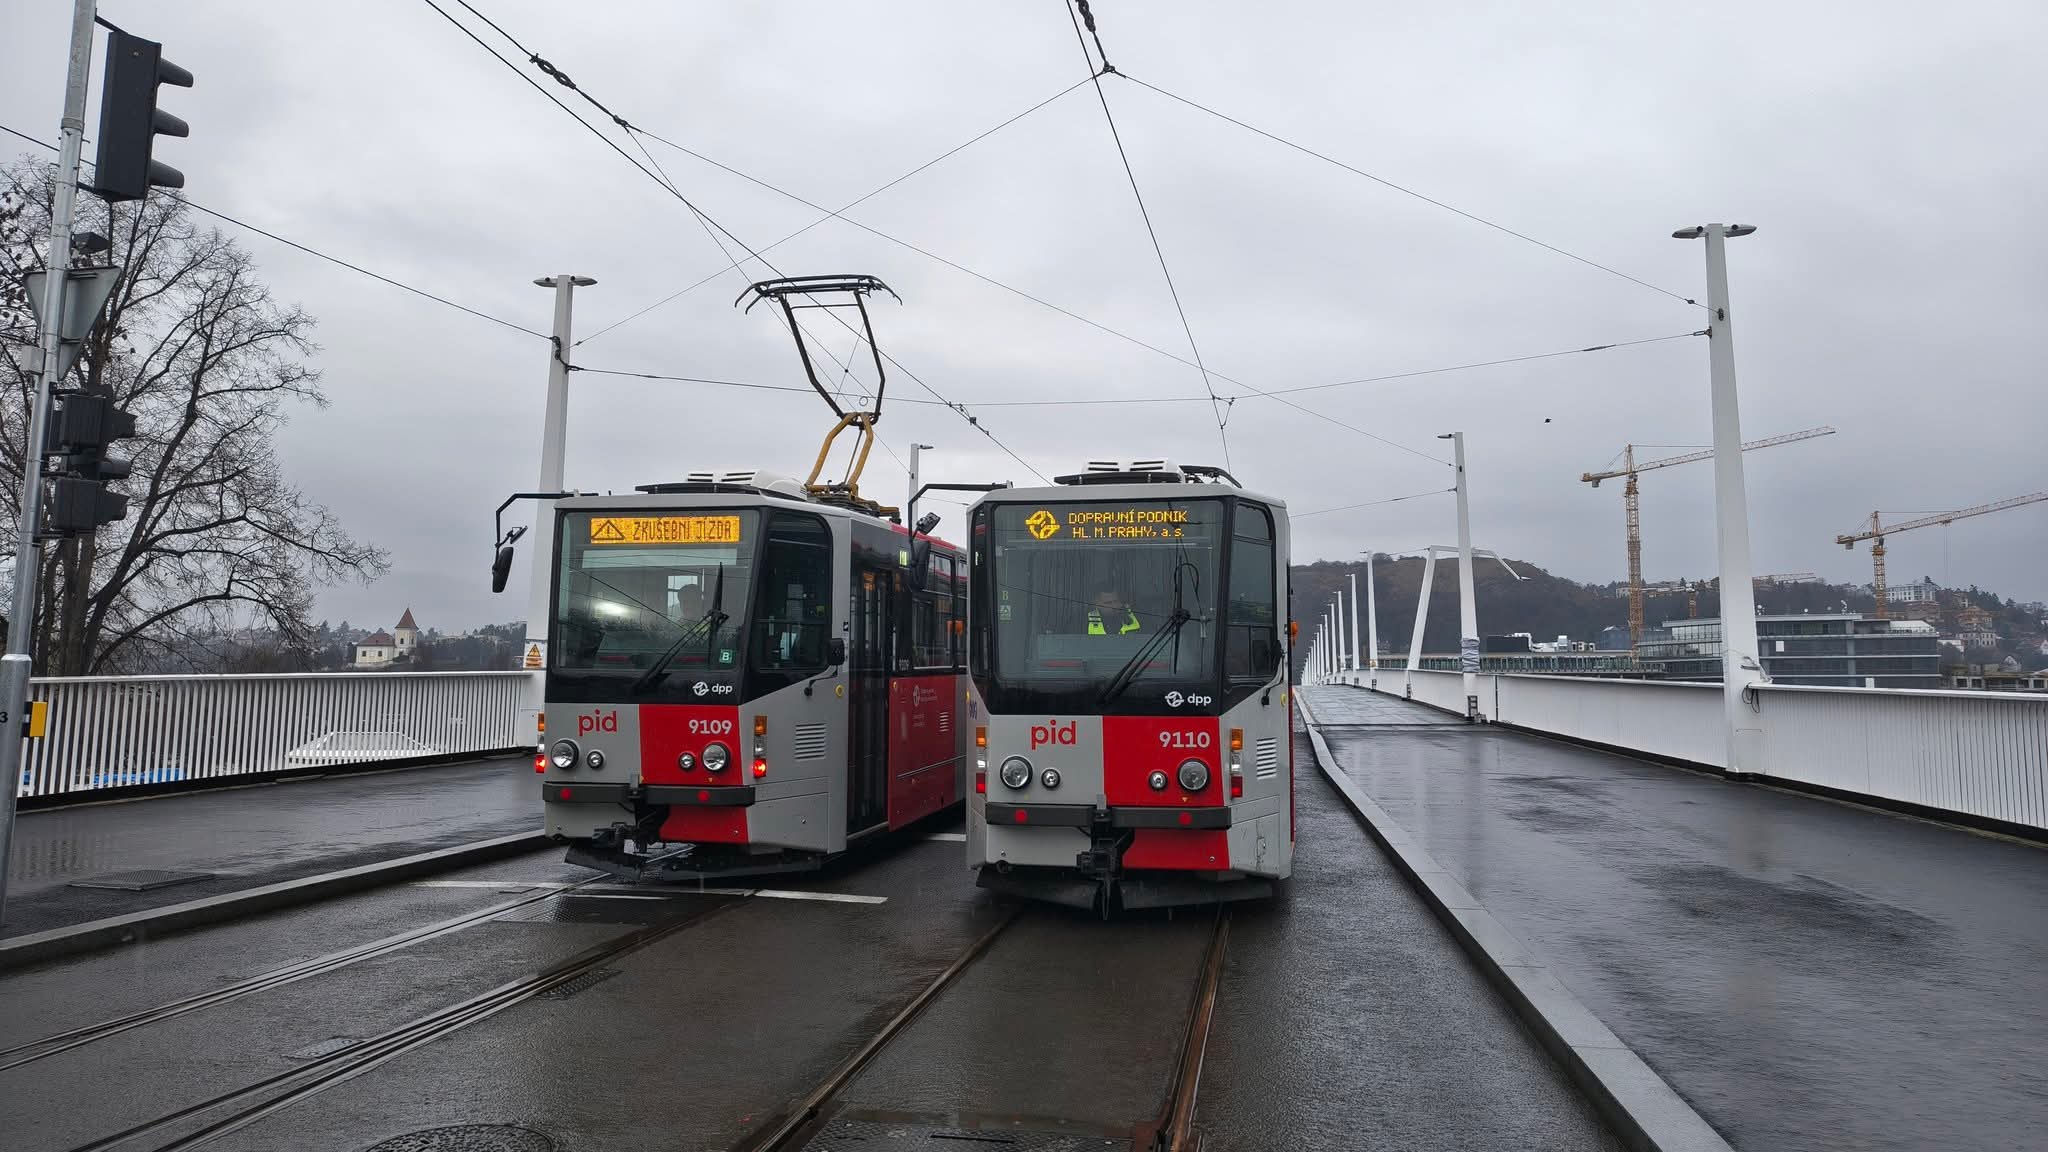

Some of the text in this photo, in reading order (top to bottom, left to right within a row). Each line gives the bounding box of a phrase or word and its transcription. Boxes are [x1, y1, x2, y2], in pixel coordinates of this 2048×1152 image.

[1137, 510, 1187, 522] PODNIK
[1072, 526, 1091, 538] HL.
[1094, 527, 1105, 538] M.
[1109, 526, 1157, 538] PRAHY,
[722, 652, 730, 660] B
[711, 683, 733, 694] dpp
[1187, 693, 1212, 706] dpp
[578, 709, 617, 737] pid
[688, 719, 733, 735] 9109
[1030, 719, 1077, 750] pid
[1159, 731, 1211, 748] 9110
